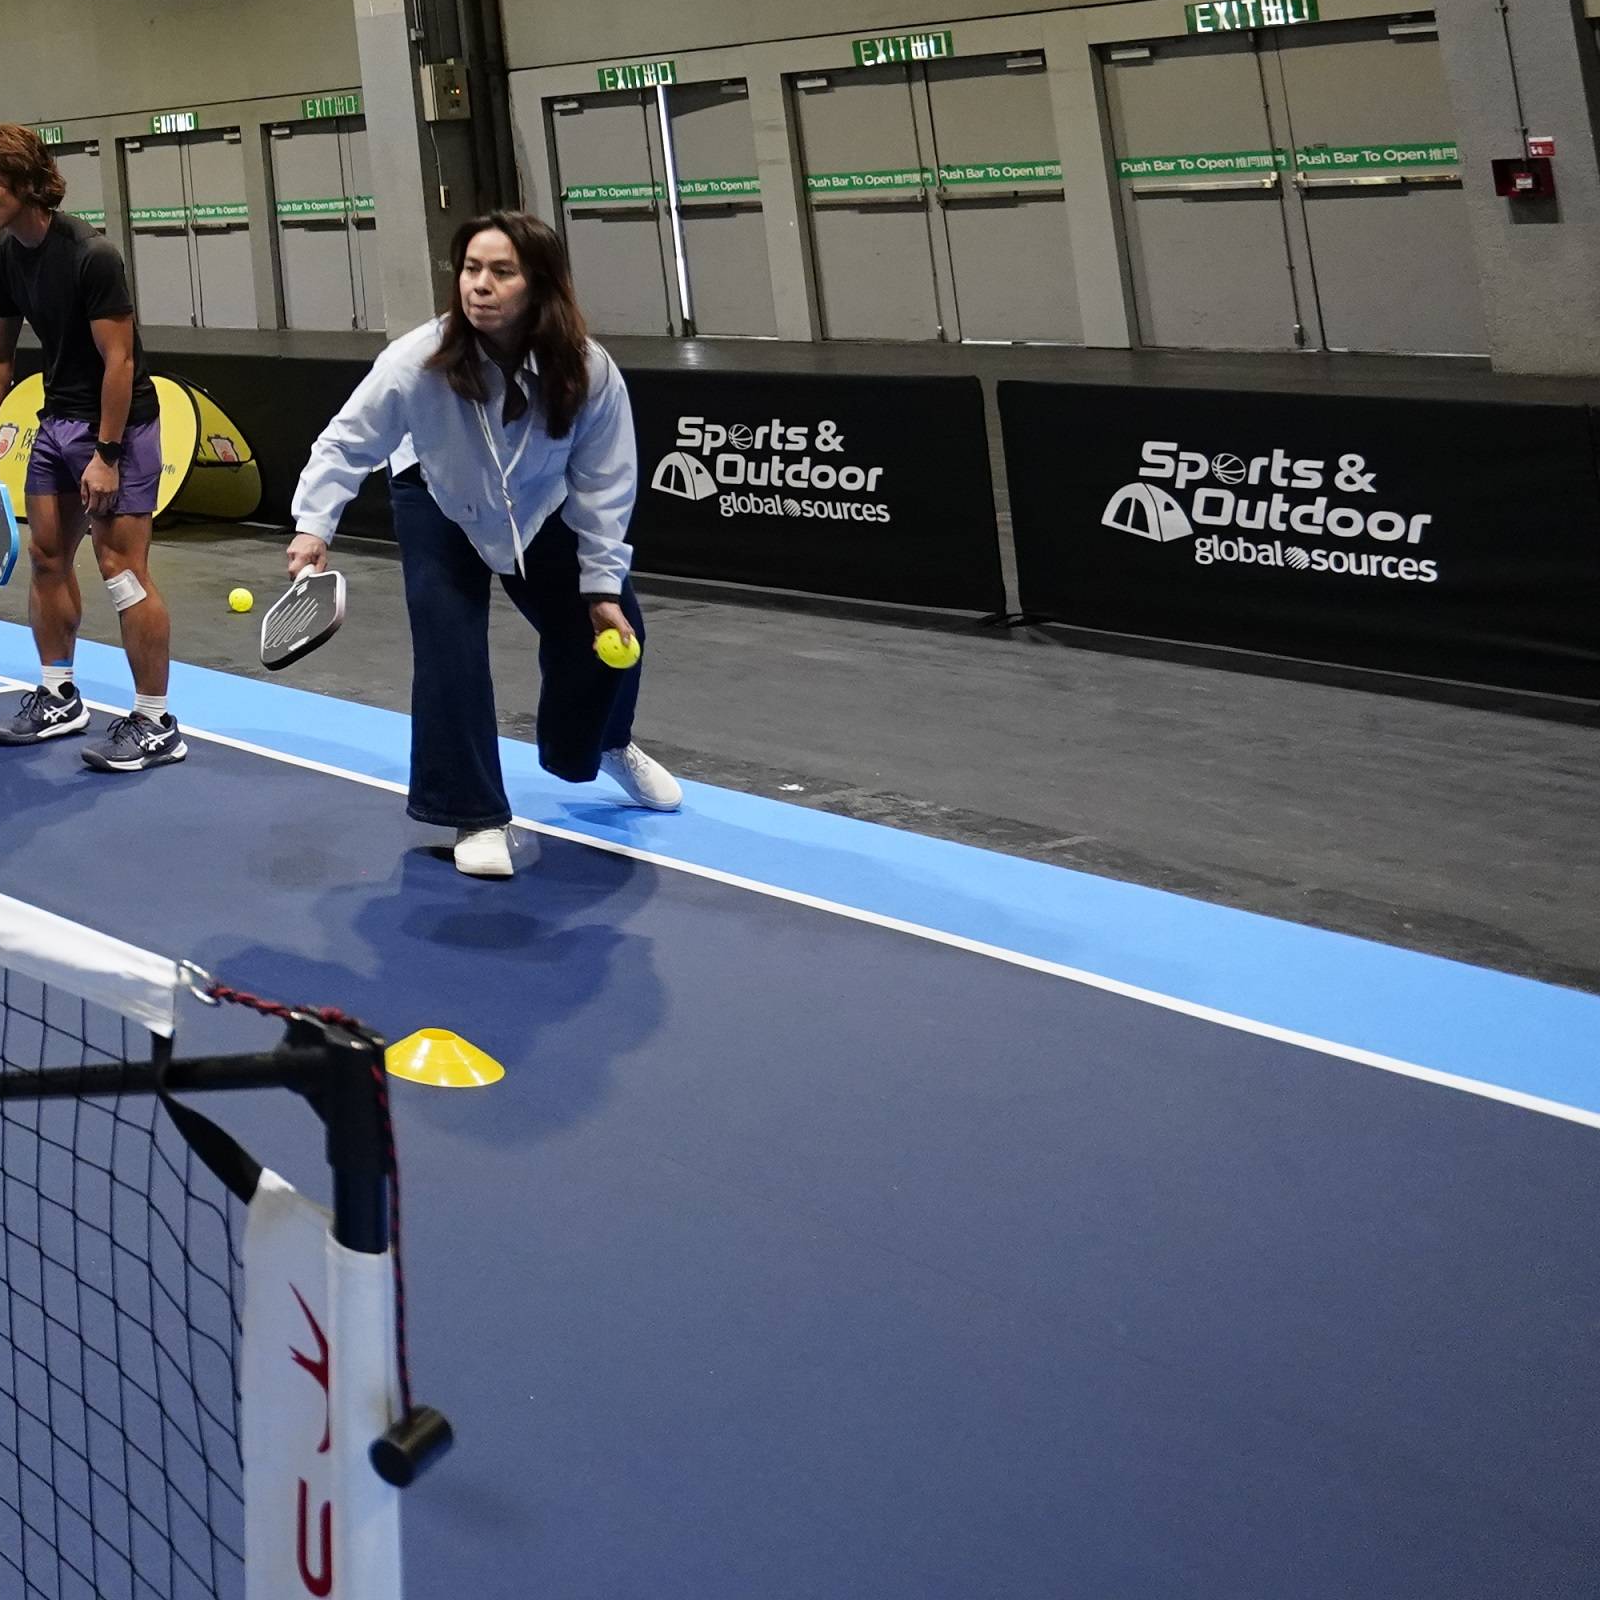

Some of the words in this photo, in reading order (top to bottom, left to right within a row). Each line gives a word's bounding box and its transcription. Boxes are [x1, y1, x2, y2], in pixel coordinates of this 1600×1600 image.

[1195, 0, 1256, 32] EXIT
[860, 36, 907, 65] EXIT
[604, 67, 641, 89] EXIT
[643, 63, 672, 85] 出口
[306, 97, 334, 118] EXIT
[153, 114, 174, 133] EXIT
[1121, 160, 1151, 173] Push
[1153, 160, 1176, 172] Bar
[1178, 159, 1194, 170] To
[1196, 157, 1234, 170] Open
[1296, 153, 1330, 165] Push
[1334, 152, 1359, 163] Bar
[1361, 150, 1380, 162] To
[1383, 149, 1427, 163] Open
[808, 177, 830, 188] Push
[832, 176, 849, 186] Bar
[851, 175, 863, 185] To
[864, 174, 893, 185] Open
[940, 169, 964, 180] Push
[966, 168, 985, 179] Bar
[986, 168, 1000, 178] To
[1002, 166, 1034, 178] Open
[568, 188, 582, 198] ush
[583, 188, 596, 198] Bar
[597, 187, 608, 197] To
[608, 187, 631, 198] Open
[695, 182, 708, 191] Bar
[709, 181, 719, 191] To
[720, 181, 743, 191] Open
[311, 202, 329, 211] Open
[676, 416, 807, 456] Sports
[816, 419, 844, 453] &
[715, 456, 883, 492] Outdoor
[1139, 441, 1325, 490] Sports
[1334, 453, 1377, 493] &
[719, 491, 783, 520] global
[801, 496, 890, 523] sources
[1191, 486, 1432, 543] Outdoor
[1194, 534, 1282, 570] global
[1309, 543, 1439, 582] sources
